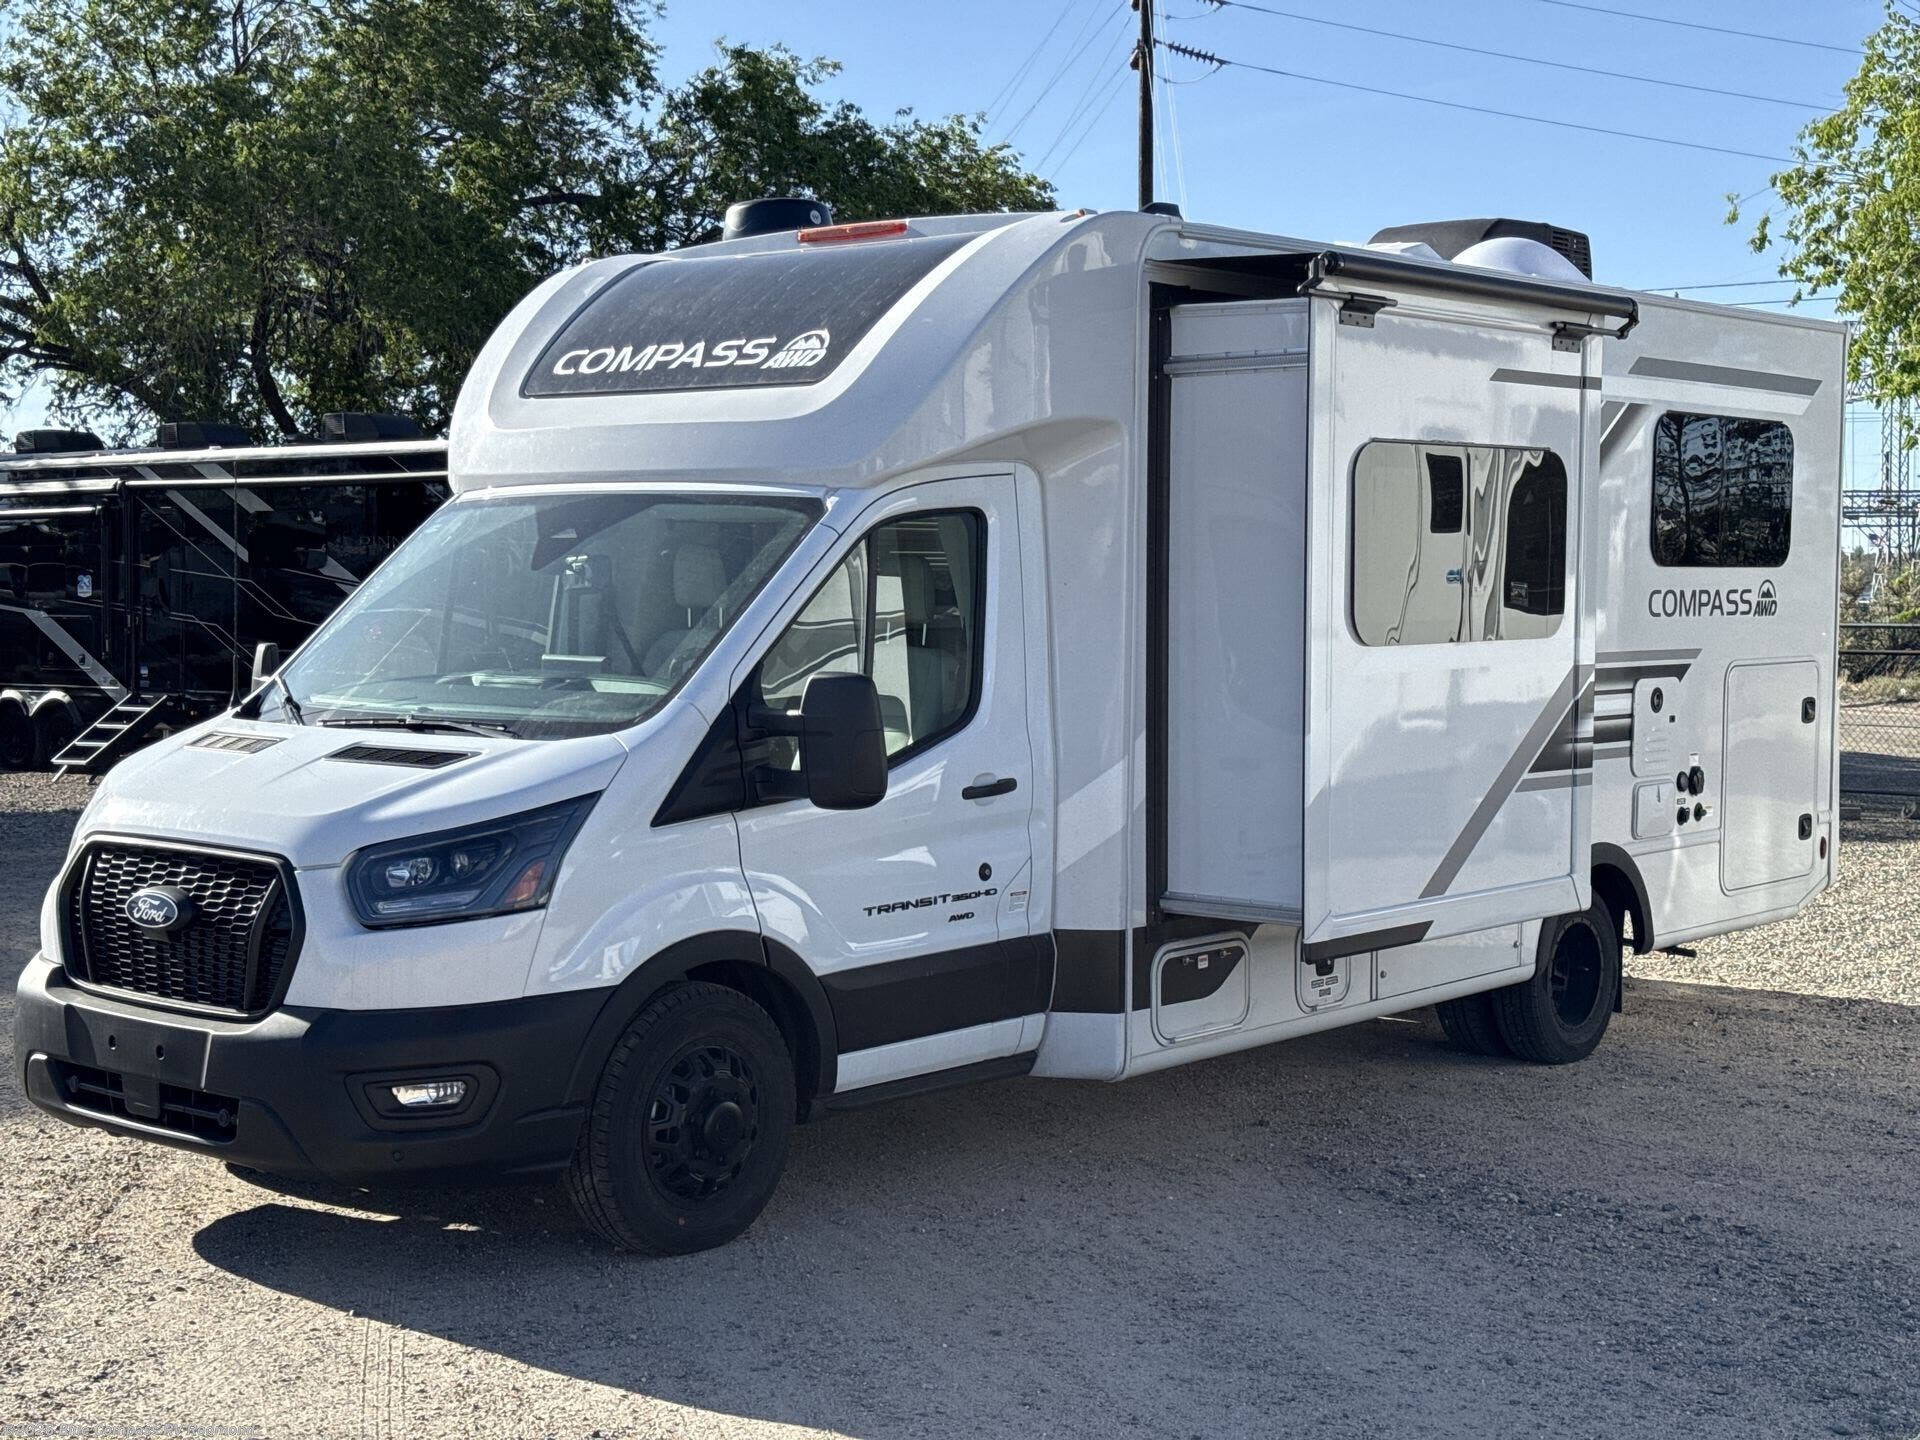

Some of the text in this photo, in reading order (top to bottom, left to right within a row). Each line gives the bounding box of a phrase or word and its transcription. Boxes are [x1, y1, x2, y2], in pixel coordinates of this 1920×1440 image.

[553, 336, 827, 375] COMPASS AWD
[1648, 588, 1778, 618] COMPASS AWD
[132, 896, 168, 923] Ford
[863, 893, 951, 917] TRANSIT
[948, 911, 975, 923] AWD
